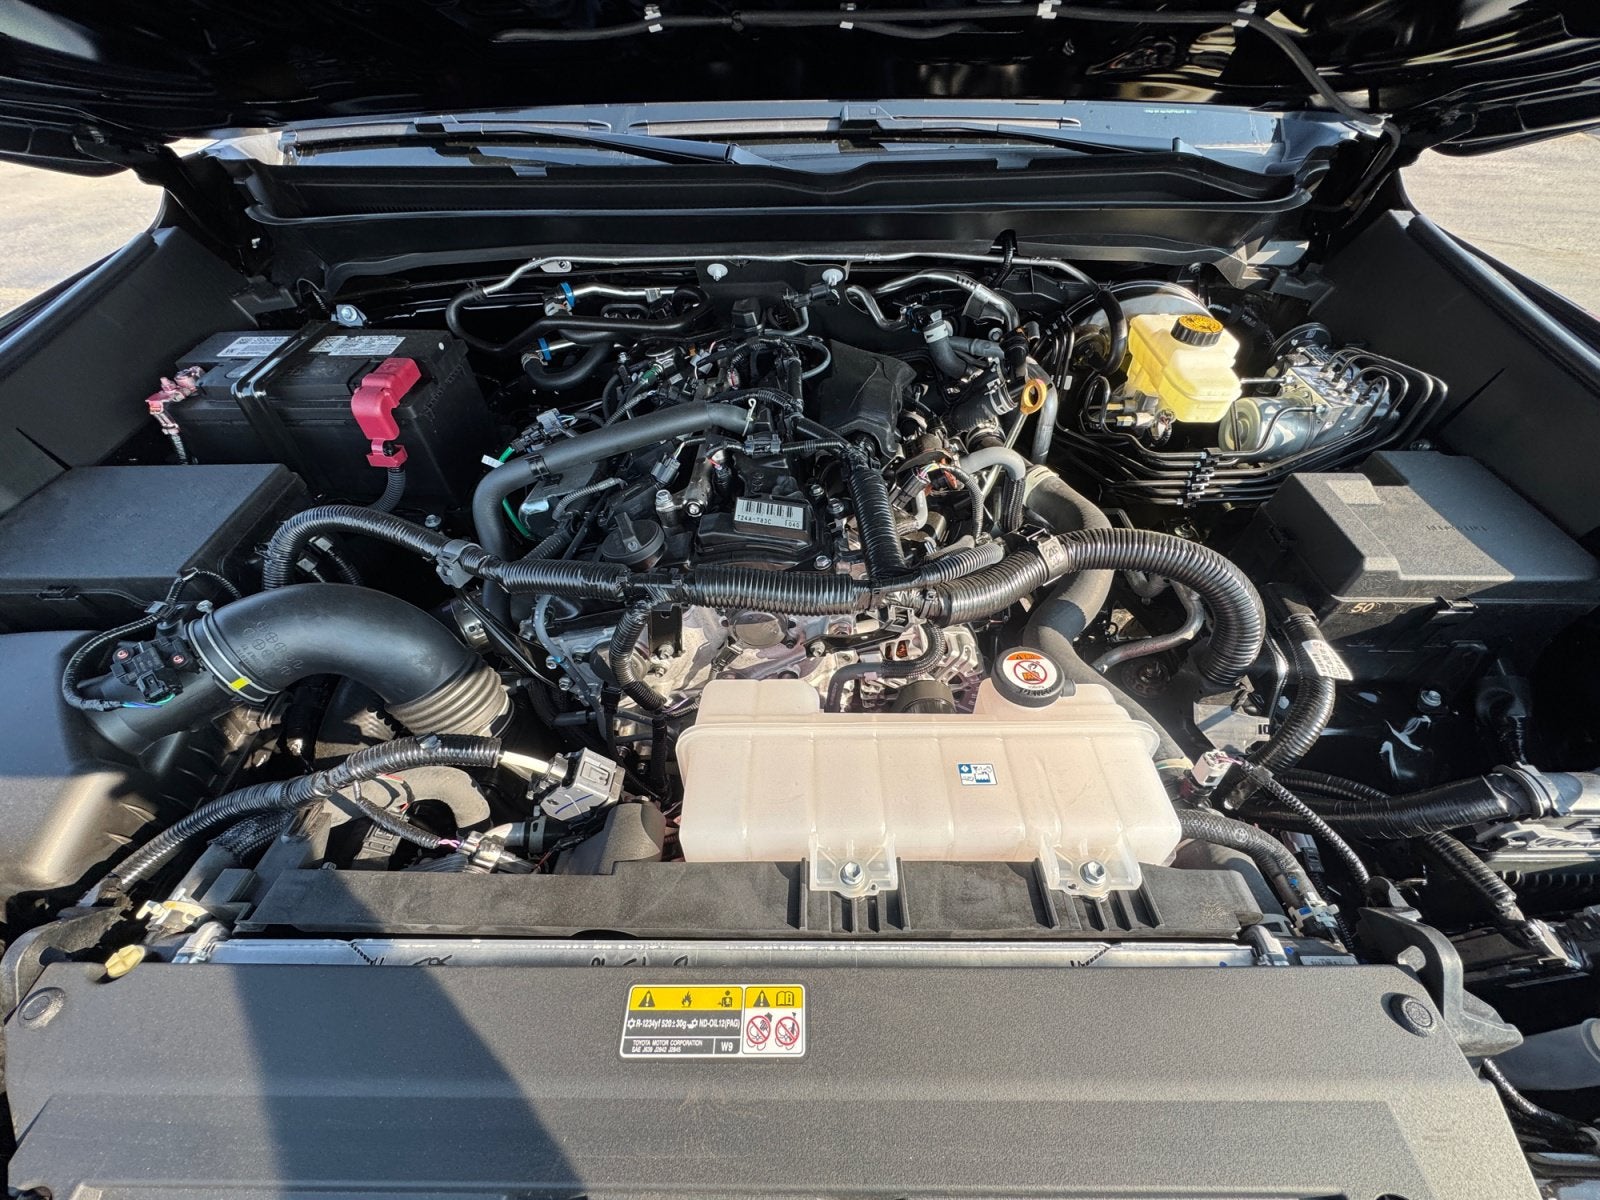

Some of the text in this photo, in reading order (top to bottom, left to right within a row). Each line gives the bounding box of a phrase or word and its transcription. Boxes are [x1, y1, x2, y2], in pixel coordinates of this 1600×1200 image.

[1351, 602, 1375, 613] 50
[633, 1039, 703, 1047] TOYOTA MOTOR CORPORATION
[721, 1041, 734, 1052] W9
